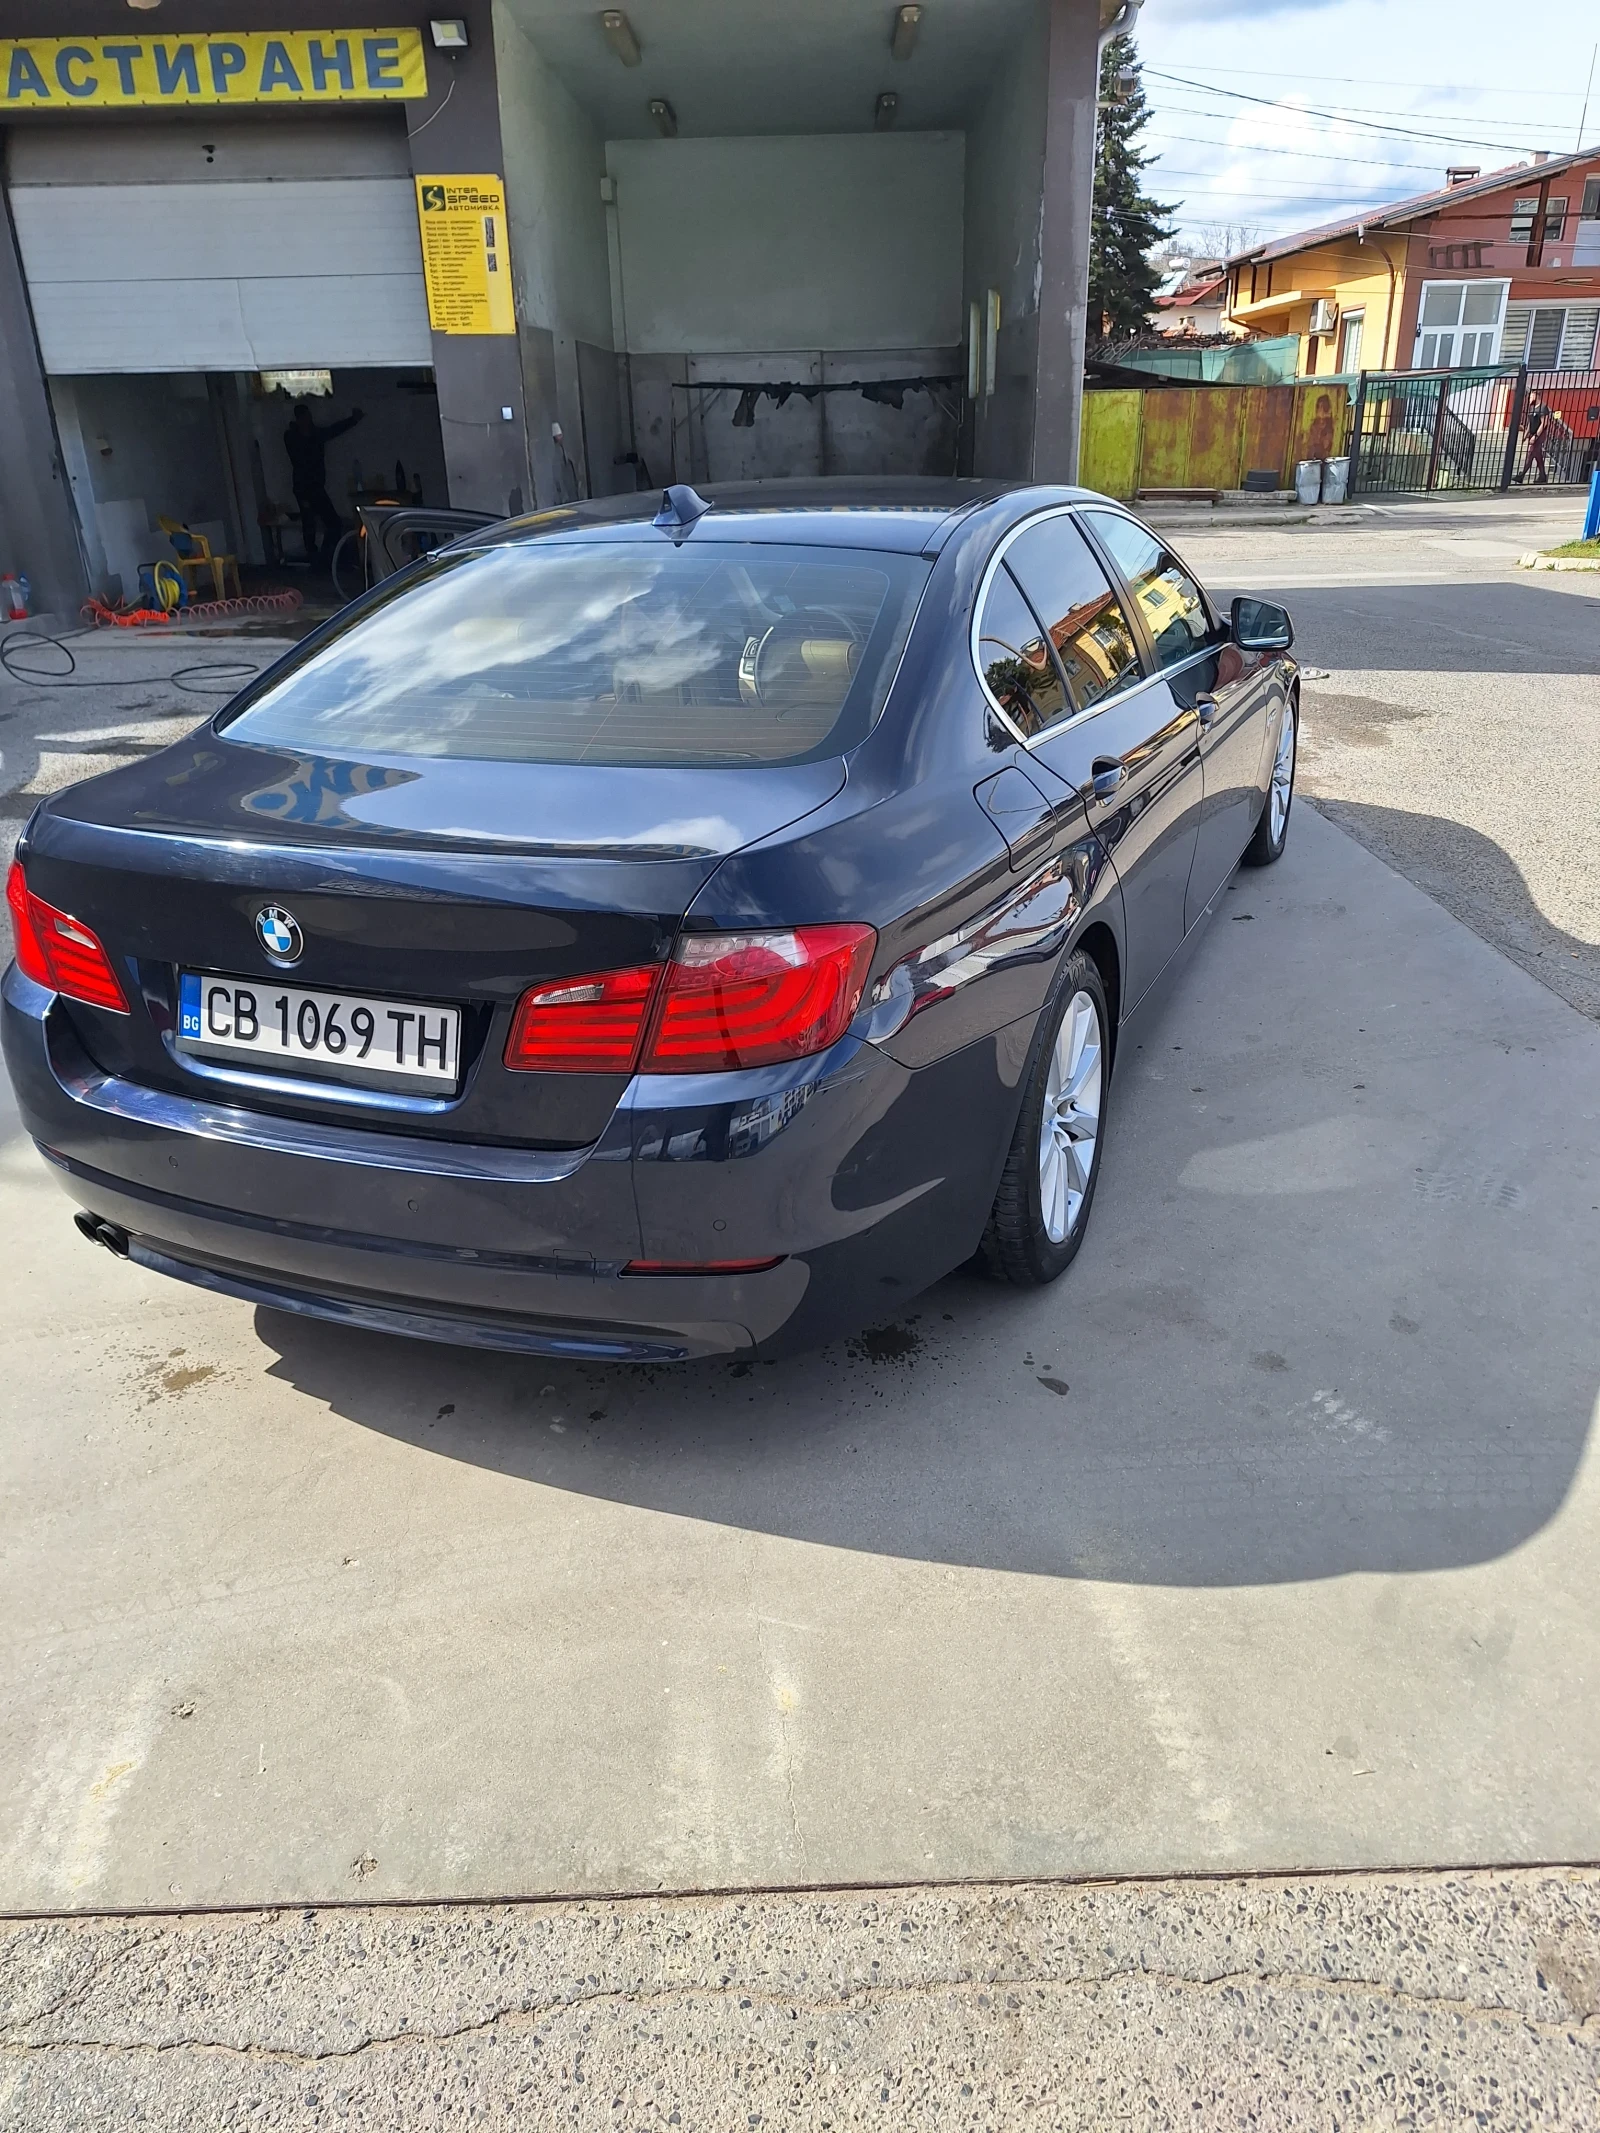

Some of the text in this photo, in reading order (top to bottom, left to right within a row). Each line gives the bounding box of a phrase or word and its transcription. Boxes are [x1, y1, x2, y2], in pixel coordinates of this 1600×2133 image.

[7, 37, 404, 99] АСТИРАНЕ
[447, 194, 500, 204] SPEED
[257, 909, 296, 929] BMW
[183, 986, 448, 1070] BG CB 1069 TH
